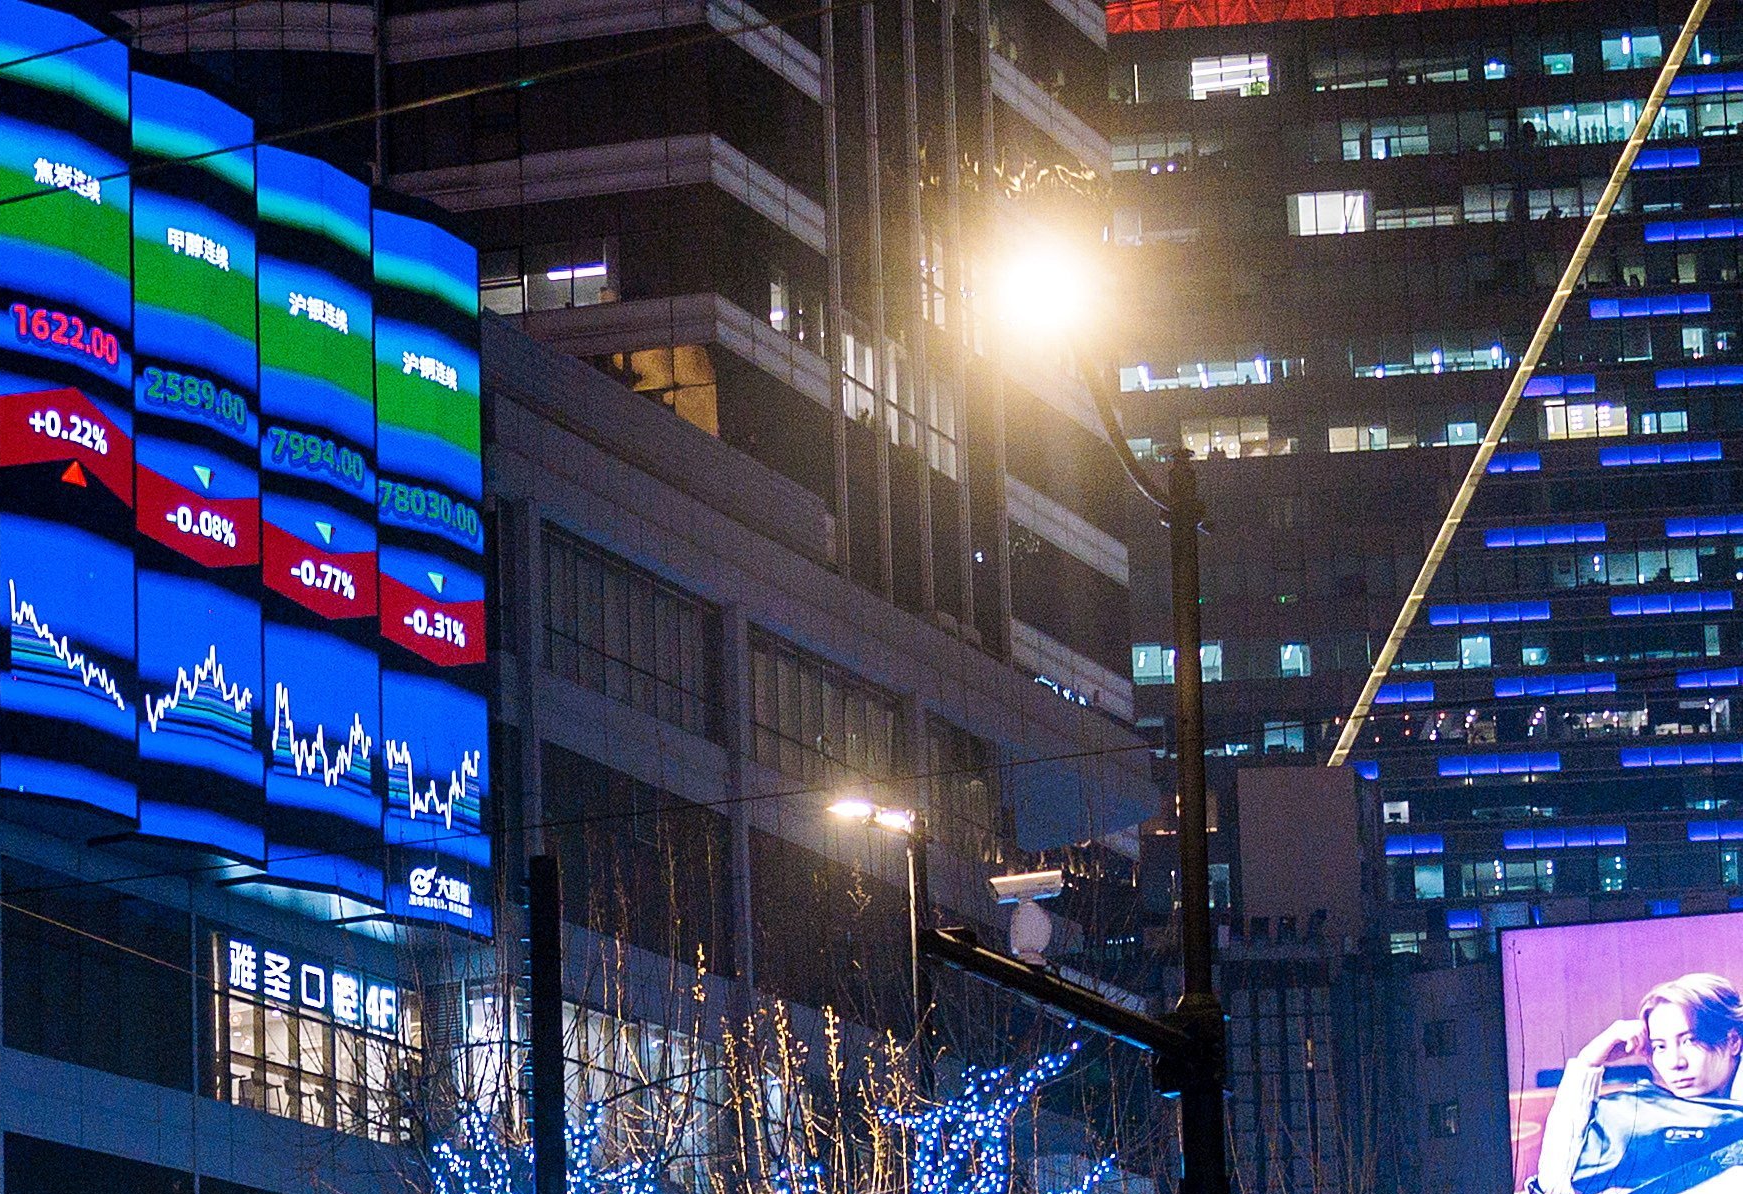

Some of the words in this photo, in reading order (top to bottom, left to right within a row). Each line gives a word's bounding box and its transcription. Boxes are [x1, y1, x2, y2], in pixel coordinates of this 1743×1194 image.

[167, 227, 230, 272] 甲醇连续
[13, 304, 119, 366] 1622.00
[289, 292, 349, 335] 沪银连续
[145, 367, 246, 427] 2589.00
[29, 410, 109, 456] +0.22%
[269, 426, 365, 483] 7994.00
[166, 505, 237, 549] -0.08%
[377, 478, 479, 537] 78030.00
[290, 560, 356, 601] -0.77%
[403, 609, 466, 649] -0.31%
